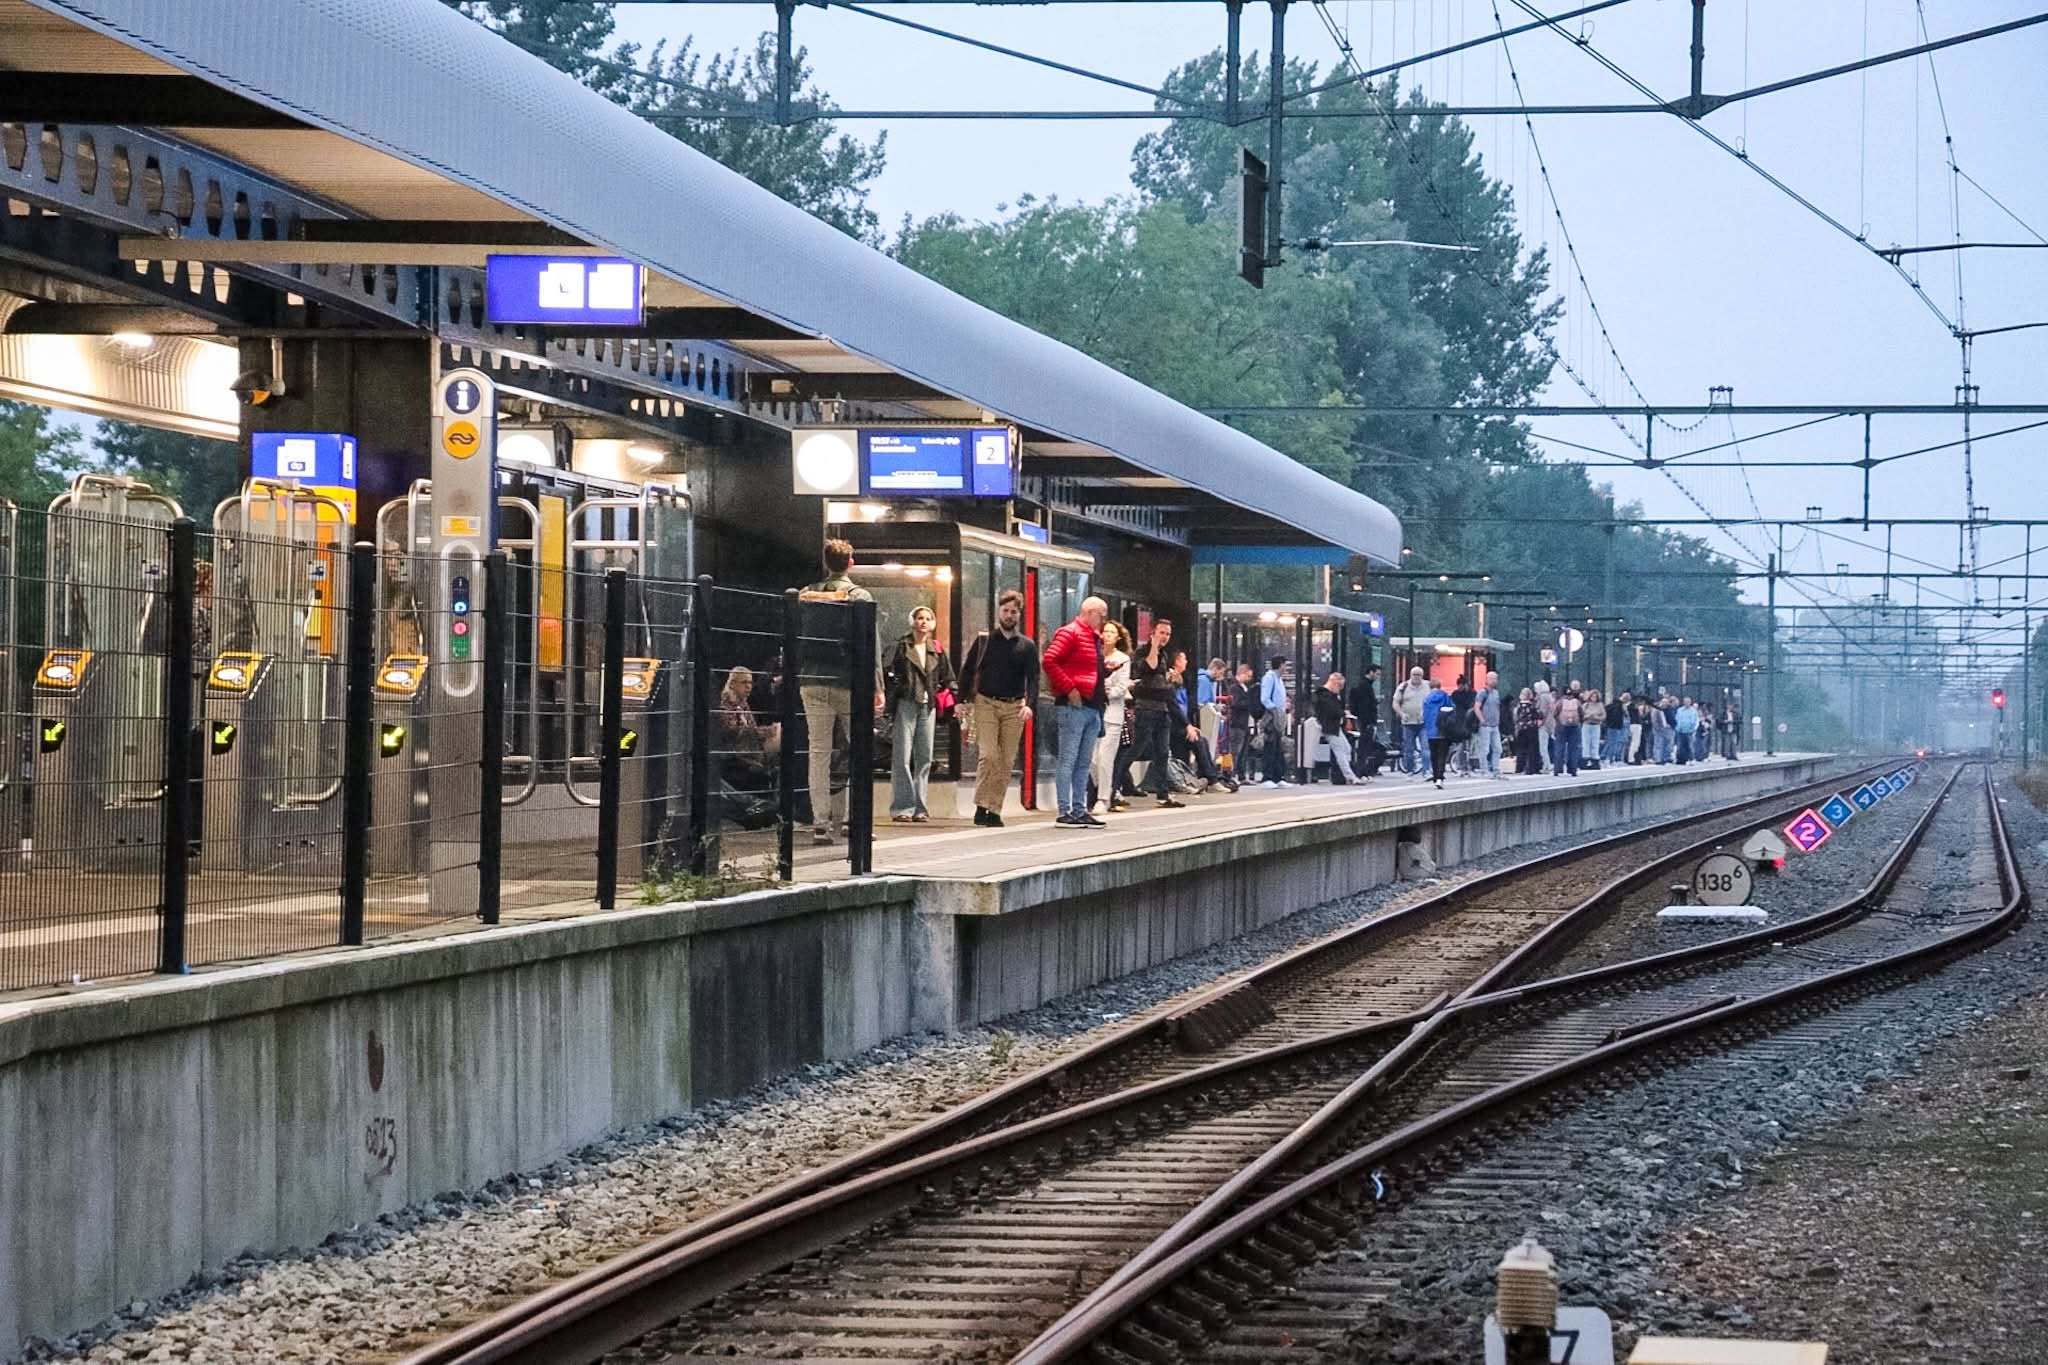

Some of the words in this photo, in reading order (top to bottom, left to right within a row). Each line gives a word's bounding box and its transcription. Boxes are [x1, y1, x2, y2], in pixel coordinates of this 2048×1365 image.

[986, 447, 996, 461] 2
[1877, 784, 1886, 796] 5
[1859, 793, 1870, 806] 4
[1831, 805, 1843, 819] 3
[1800, 823, 1816, 841] 2
[1700, 873, 1732, 892] 138
